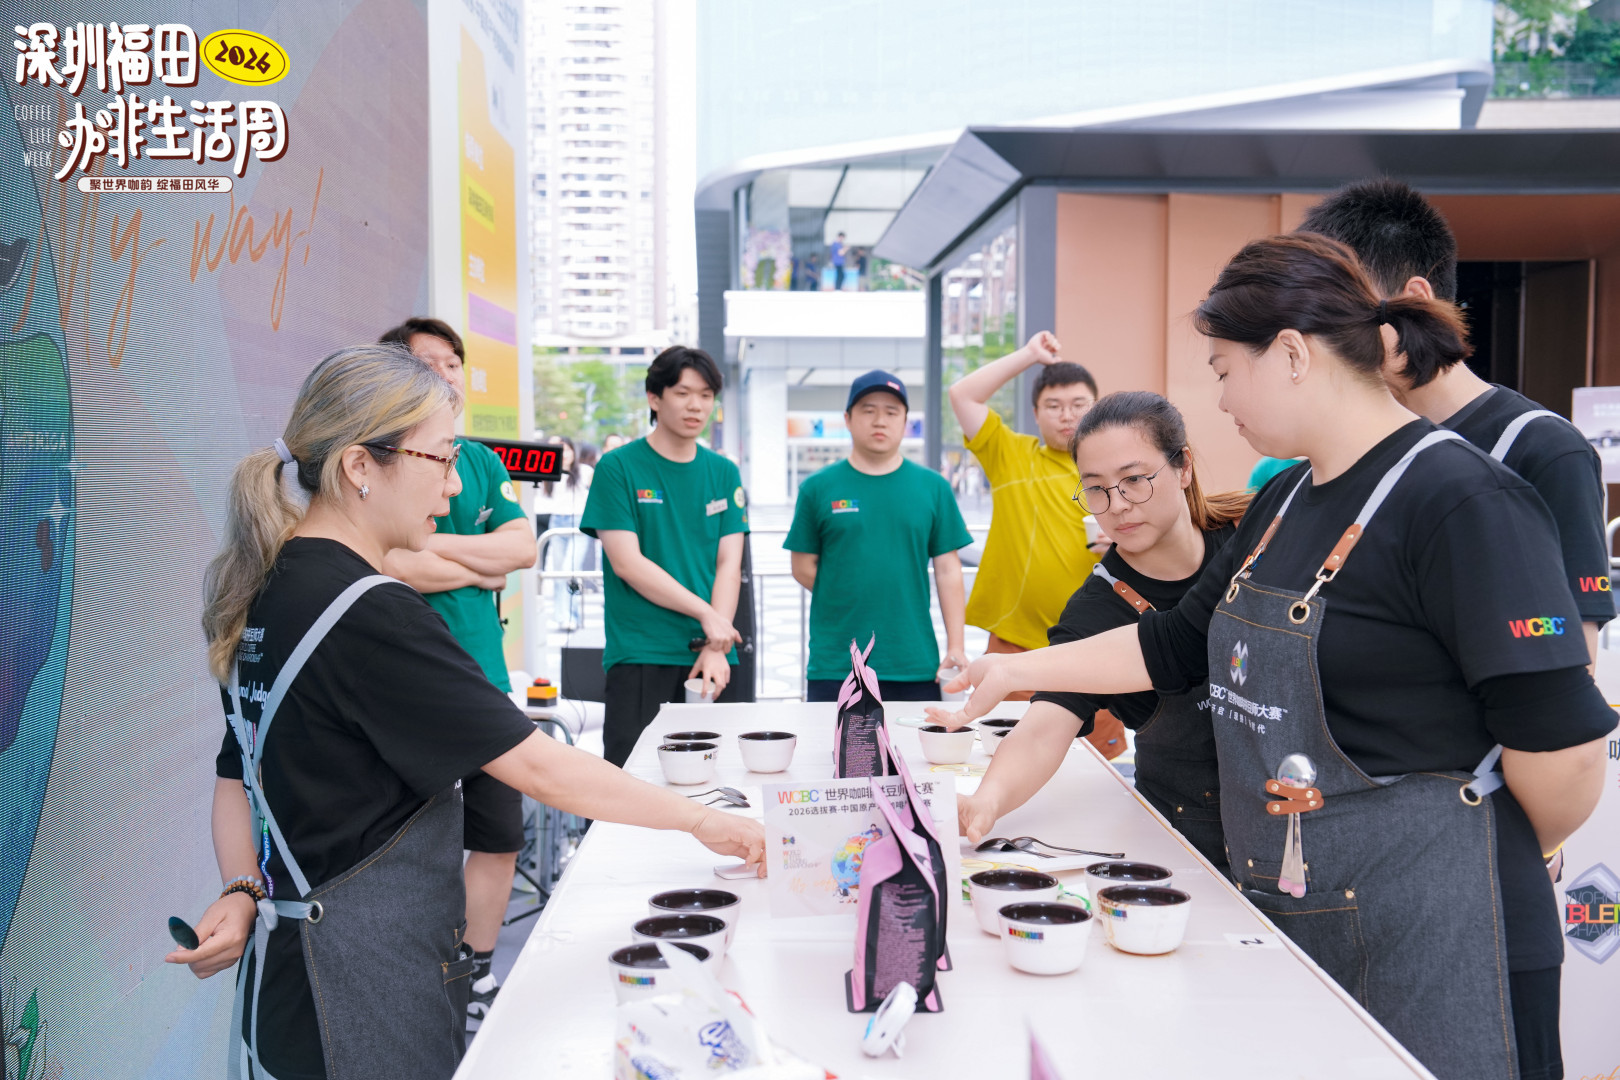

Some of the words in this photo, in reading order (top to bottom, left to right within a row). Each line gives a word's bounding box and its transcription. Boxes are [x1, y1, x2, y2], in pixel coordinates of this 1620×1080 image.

[190, 166, 324, 332] way!
[1579, 576, 1612, 592] WC
[1508, 617, 1566, 638] WCBC
[777, 789, 820, 804] WCBC
